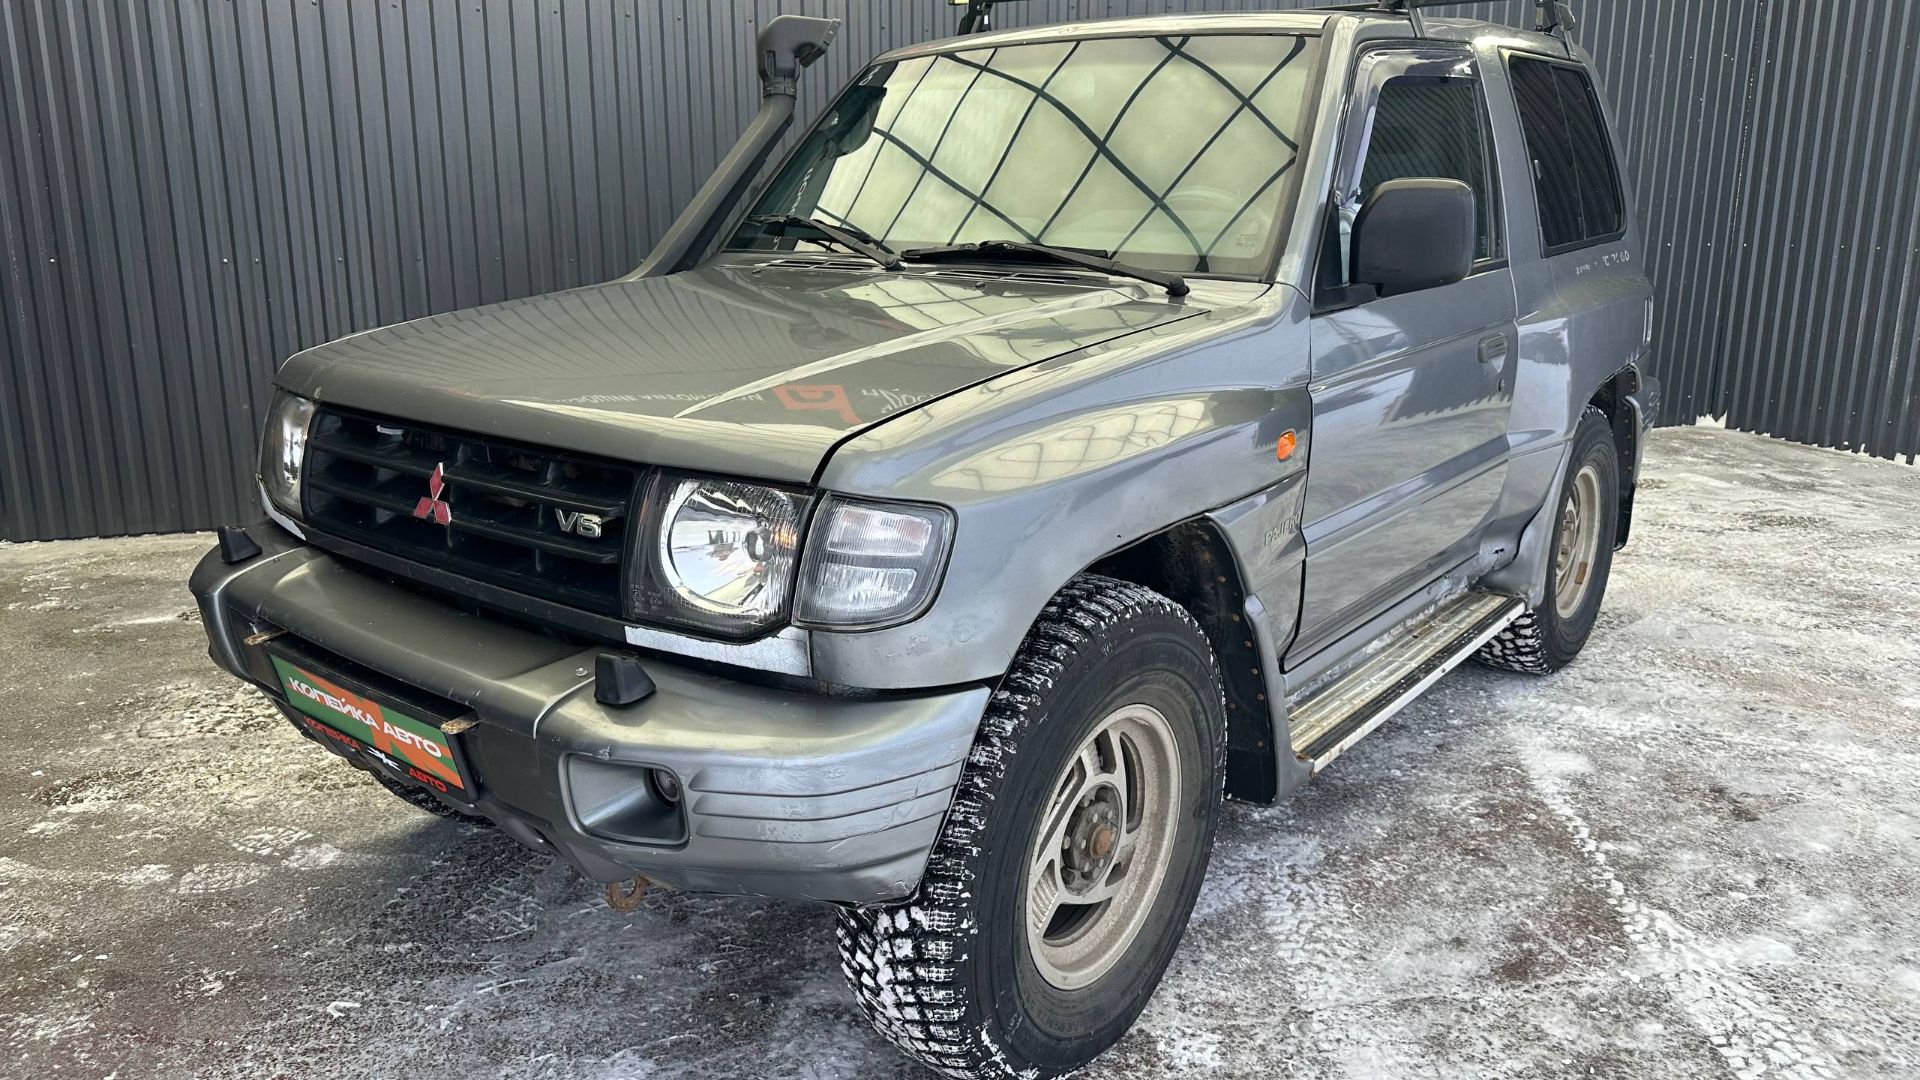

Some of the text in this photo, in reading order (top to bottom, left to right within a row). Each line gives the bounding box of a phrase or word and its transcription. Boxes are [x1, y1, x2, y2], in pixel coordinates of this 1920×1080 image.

[554, 508, 602, 538] V6
[289, 676, 442, 757] КОПЕЙКА АВТО
[408, 766, 448, 792] АВТО
